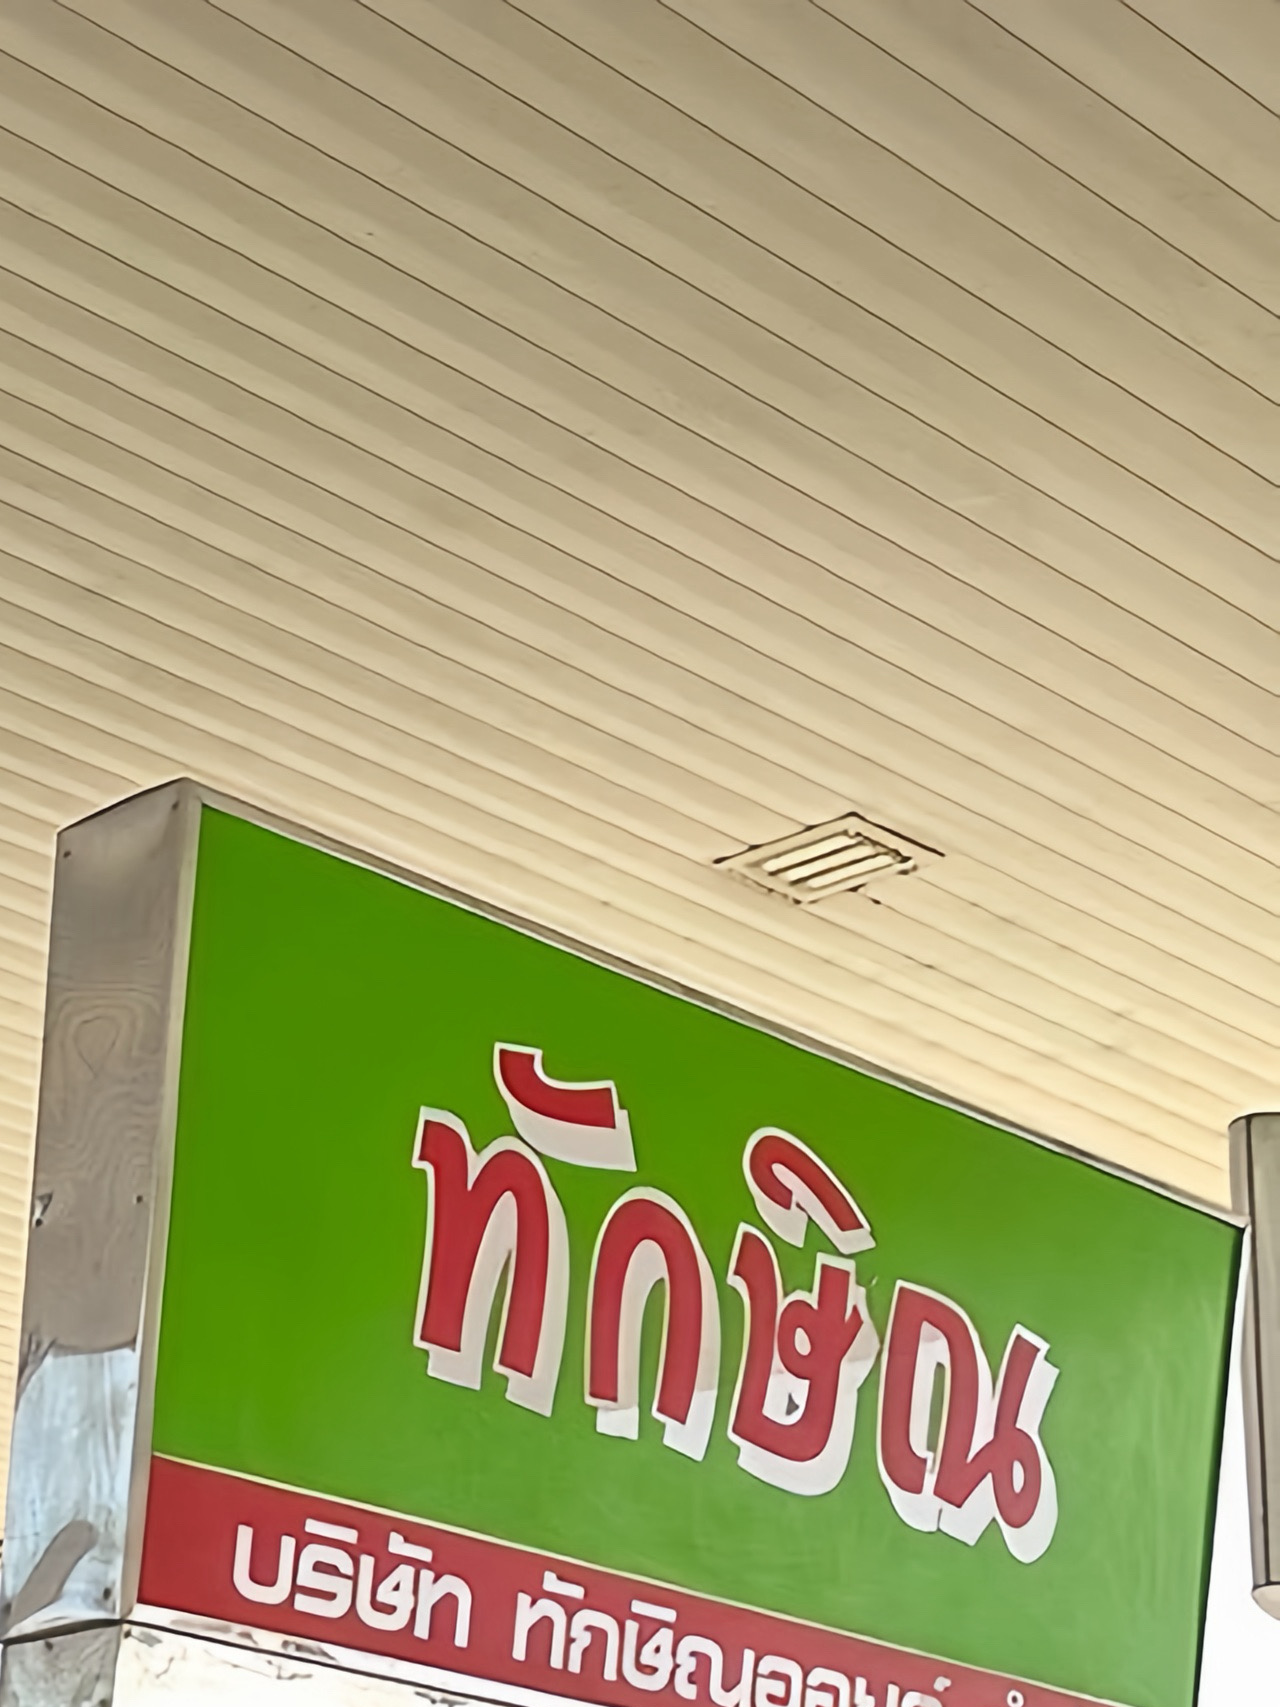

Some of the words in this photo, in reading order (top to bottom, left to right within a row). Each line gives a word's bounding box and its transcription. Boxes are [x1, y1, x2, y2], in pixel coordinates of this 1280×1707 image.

[412, 1042, 1062, 1564] ทักษิณ
[230, 1517, 473, 1649] บริษัท
